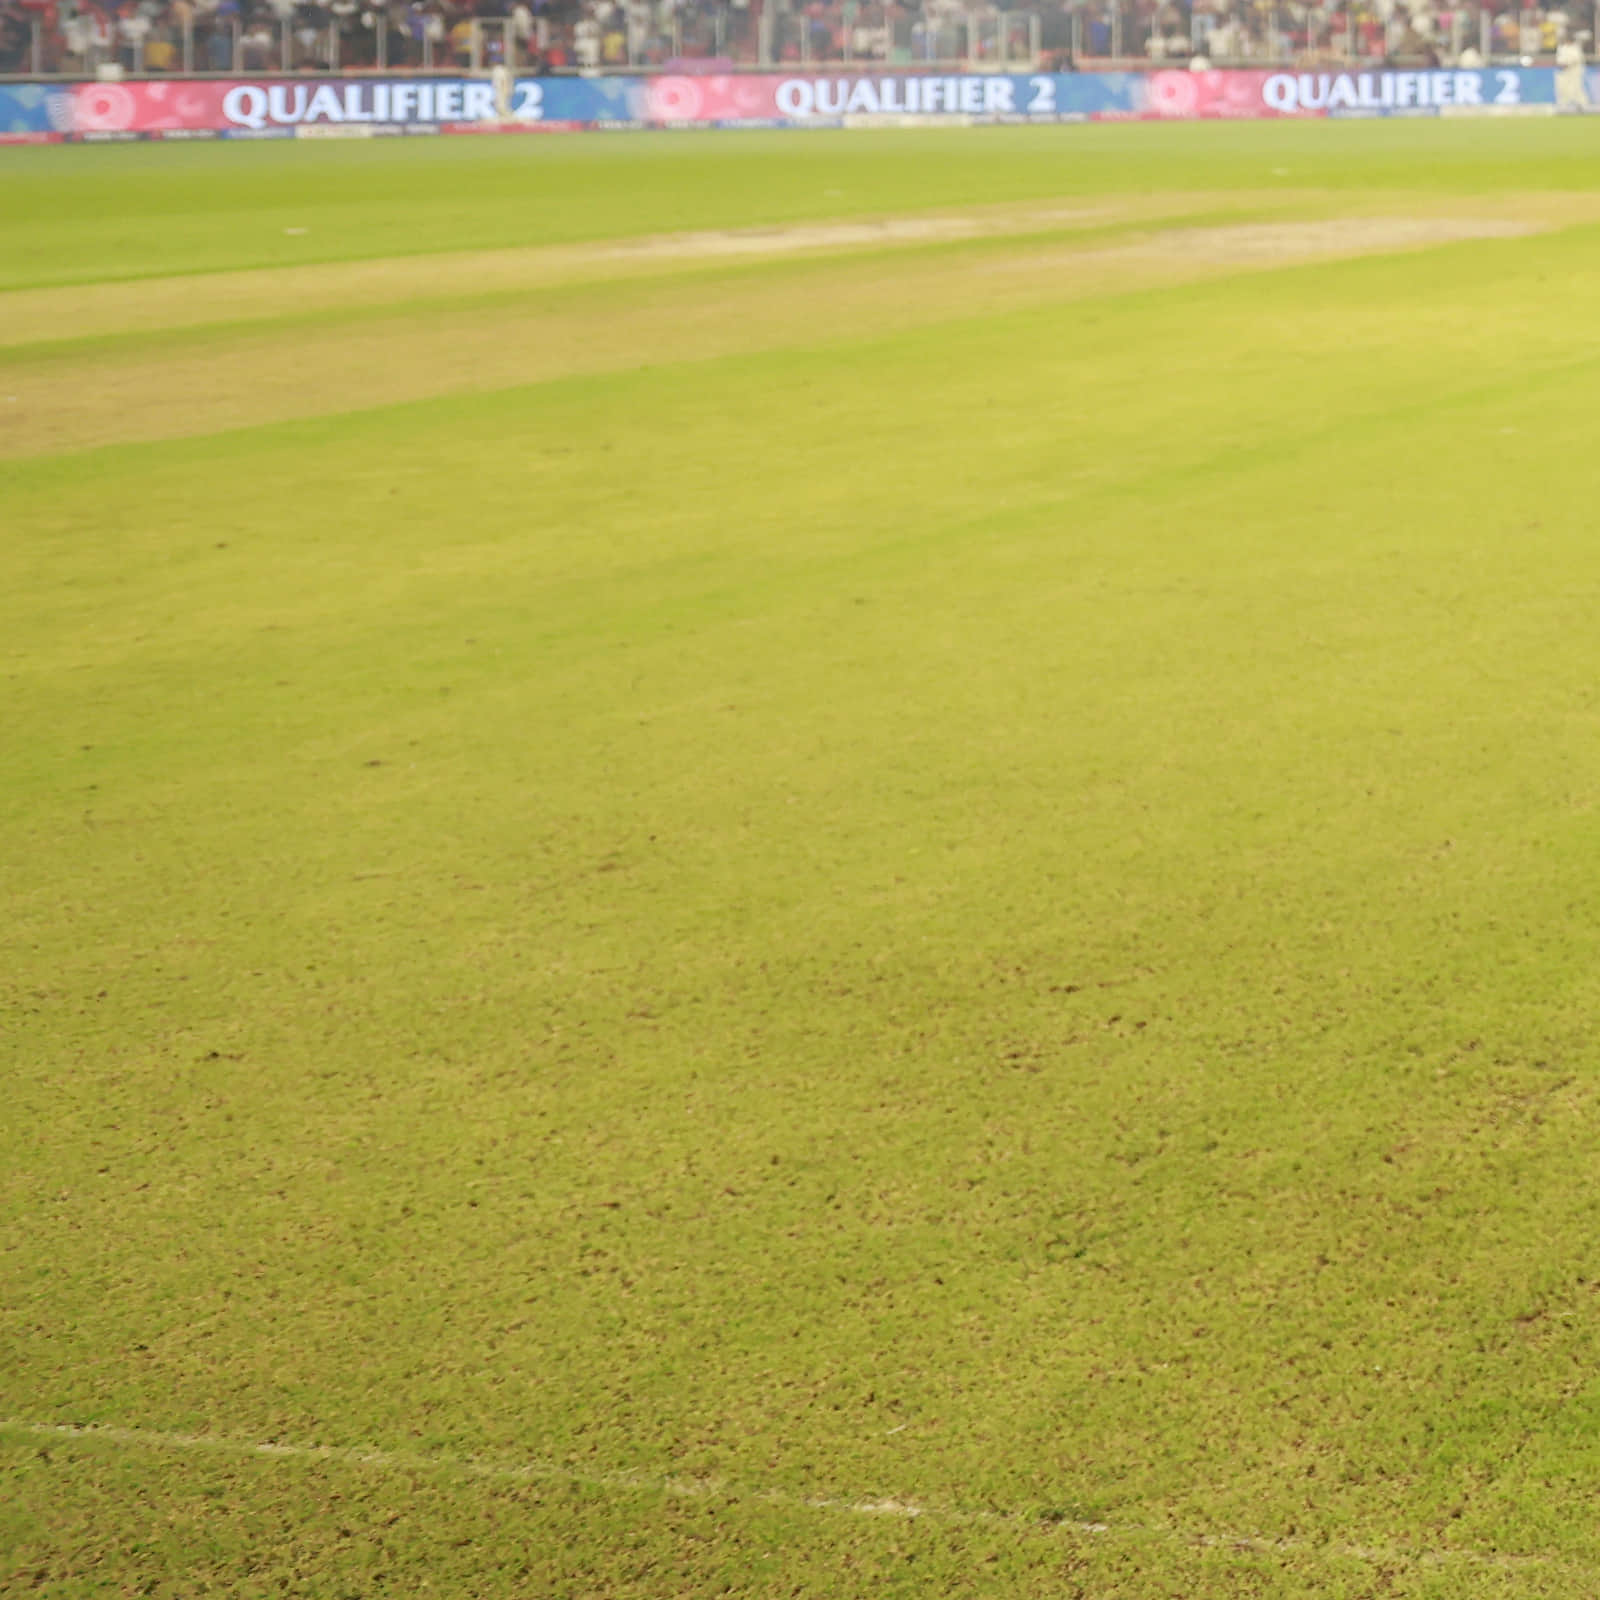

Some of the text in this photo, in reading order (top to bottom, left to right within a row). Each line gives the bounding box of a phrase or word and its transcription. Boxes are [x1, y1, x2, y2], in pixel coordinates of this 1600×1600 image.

[223, 81, 544, 126] QUALIFIER 2
[775, 78, 1056, 118] QUALIFIER 2
[1262, 70, 1521, 112] QUALIFIER 2
